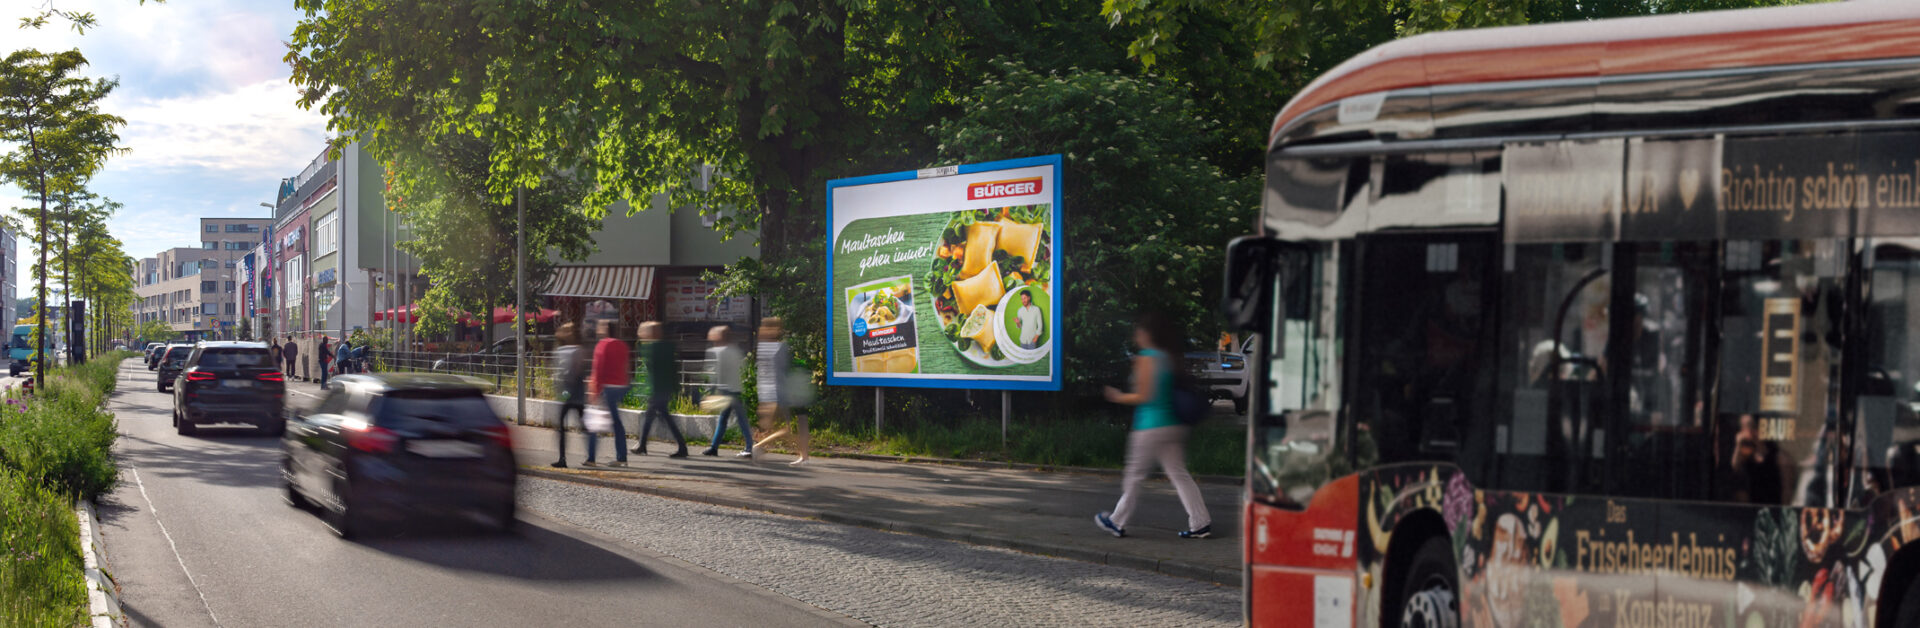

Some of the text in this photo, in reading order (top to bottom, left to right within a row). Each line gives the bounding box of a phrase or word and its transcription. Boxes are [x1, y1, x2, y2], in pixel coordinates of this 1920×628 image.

[974, 182, 1036, 198] BÜRGER
[1717, 164, 1797, 222] Richtig
[1802, 161, 1871, 209] schön
[841, 226, 905, 254] Maultaschen
[860, 241, 933, 277] gehen immer!
[1764, 383, 1792, 397] EDEKA
[1758, 418, 1796, 441] BAUR
[1606, 499, 1627, 523] Das
[1576, 528, 1737, 581] Frischeerlebnis
[1614, 588, 1714, 628] Konstanz
